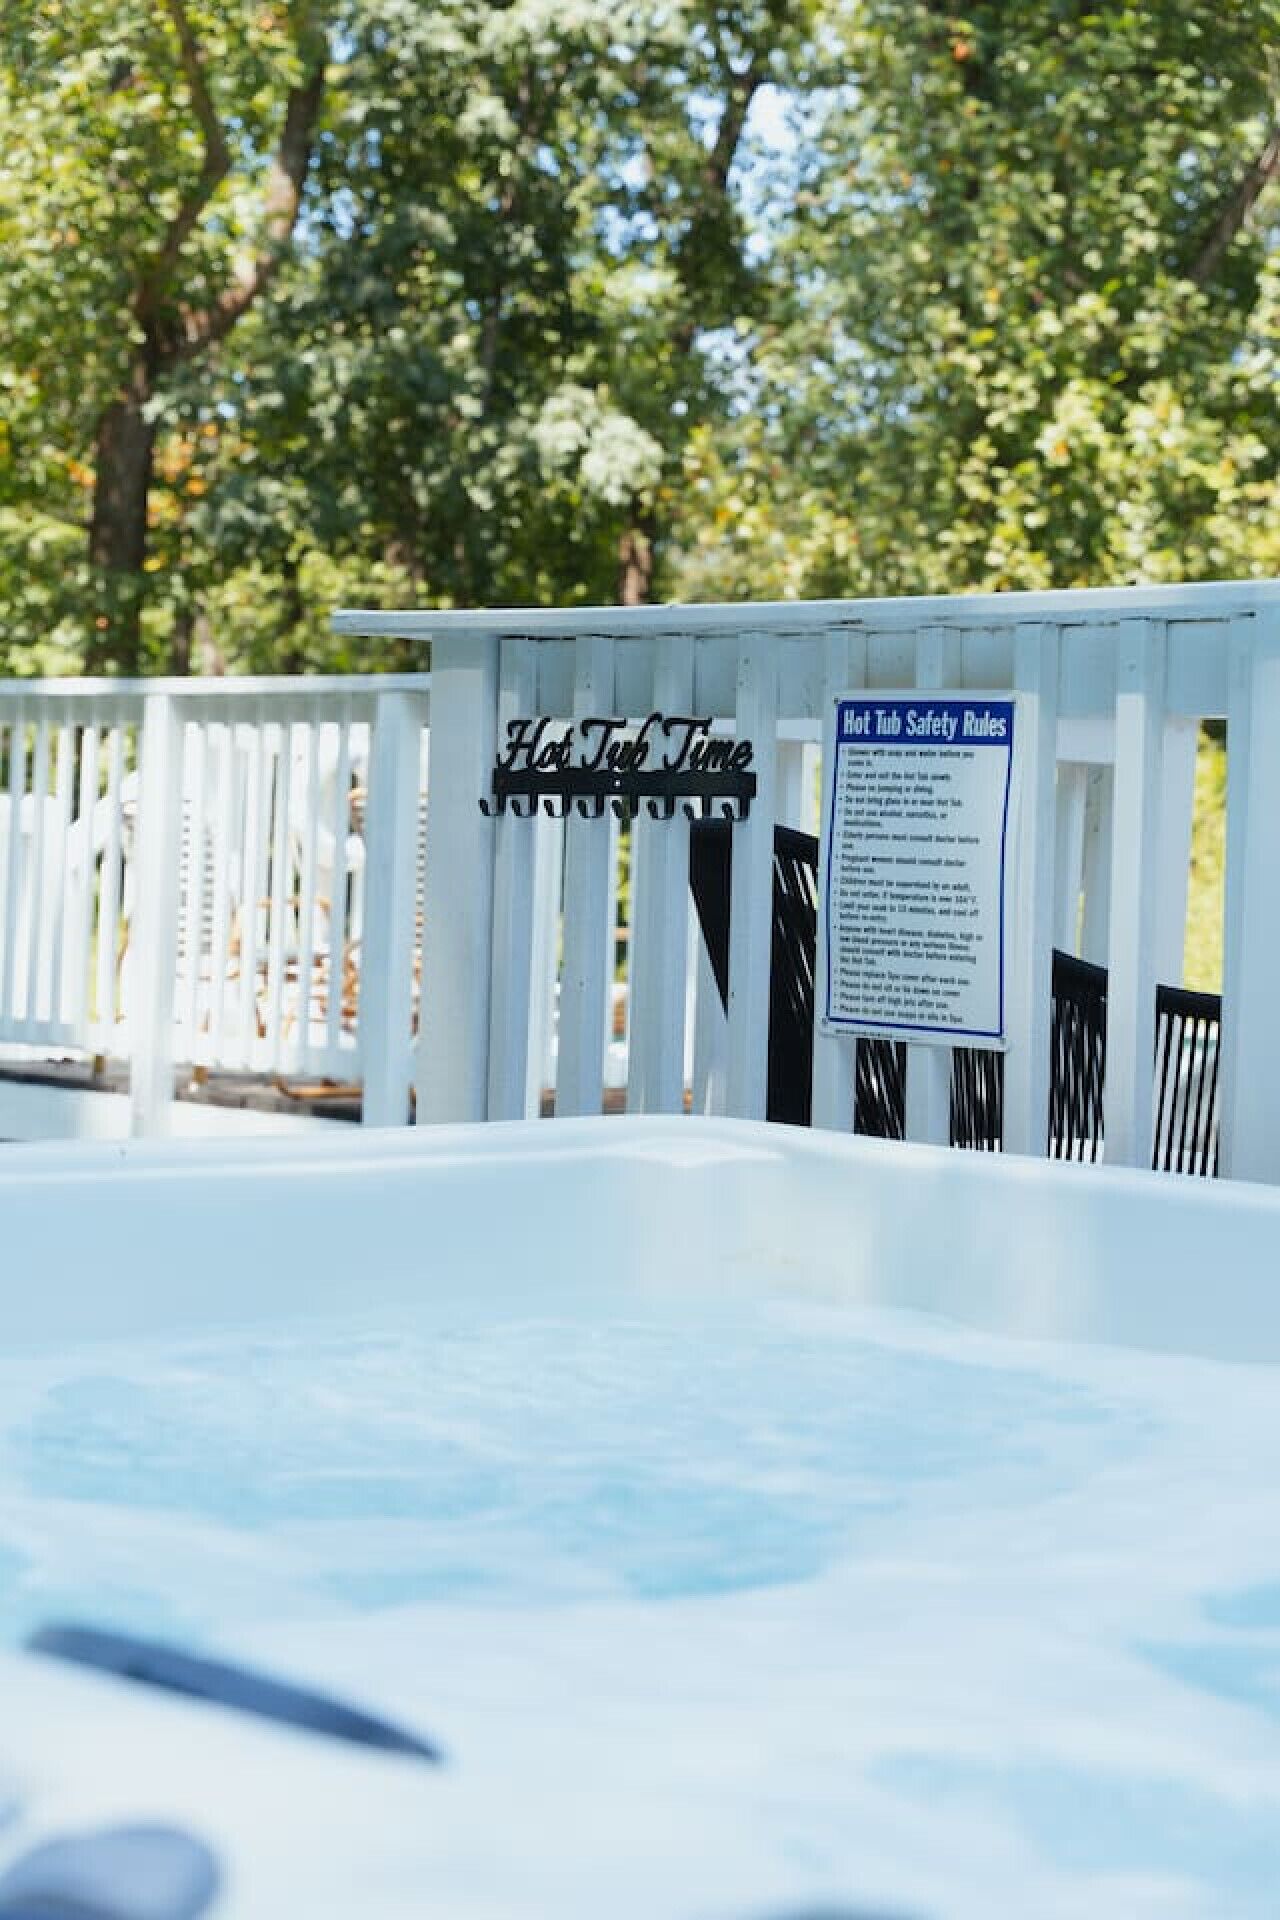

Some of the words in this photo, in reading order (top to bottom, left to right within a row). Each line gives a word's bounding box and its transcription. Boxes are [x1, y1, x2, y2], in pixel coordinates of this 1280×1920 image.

[497, 716, 574, 770] Hot
[580, 712, 663, 770] Tub
[661, 717, 753, 772] Time
[844, 709, 870, 735] Hot
[874, 709, 902, 735] Tub
[906, 709, 958, 741] Safety
[962, 709, 1007, 737] Rules
